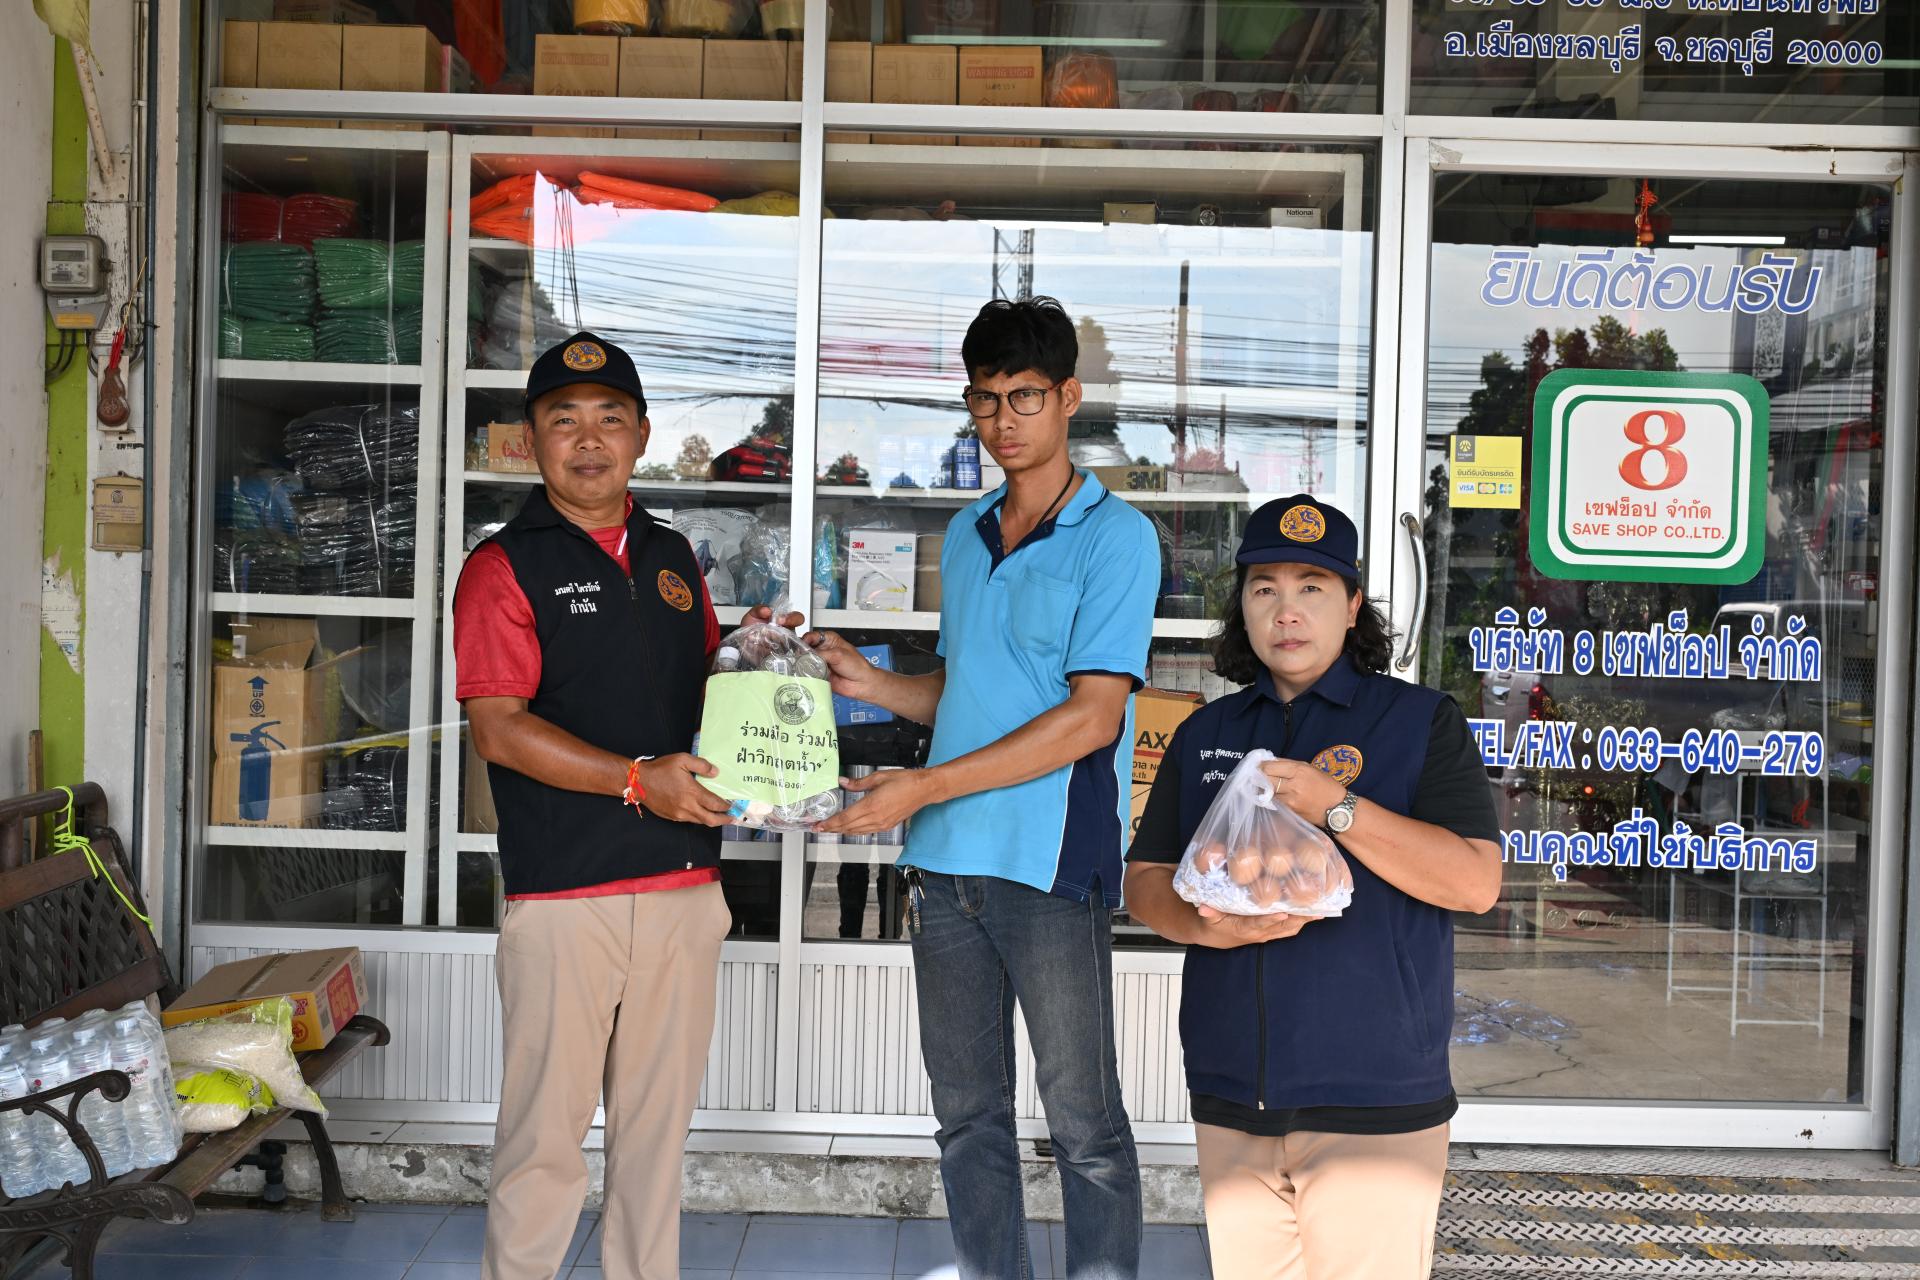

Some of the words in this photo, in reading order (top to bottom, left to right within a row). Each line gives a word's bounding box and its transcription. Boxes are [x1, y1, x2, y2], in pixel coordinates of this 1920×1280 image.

[1444, 20, 1641, 73] อ.เมืองชลบุรี
[1655, 28, 1774, 76] จ.ชลบุรี
[1786, 40, 1883, 66] 20000
[1286, 208, 1314, 217] National
[1480, 248, 1823, 315] ยินดีต้อนรับ
[1618, 409, 1688, 491] 8
[1126, 471, 1161, 489] 3M
[1666, 498, 1711, 519] จำกัด
[1572, 523, 1610, 536] SAVE
[1616, 524, 1658, 537] SHOP
[851, 541, 865, 550] 3M
[570, 597, 597, 614] กำนัน
[1469, 606, 1564, 674] บริษัท
[1573, 630, 1595, 675] 8
[1602, 607, 1731, 679] เซฟช็อป
[1738, 614, 1822, 681] จำกัด
[740, 721, 789, 743] ร่วมมือ
[737, 747, 828, 772] ฝ่าวิกฤตน้ำ
